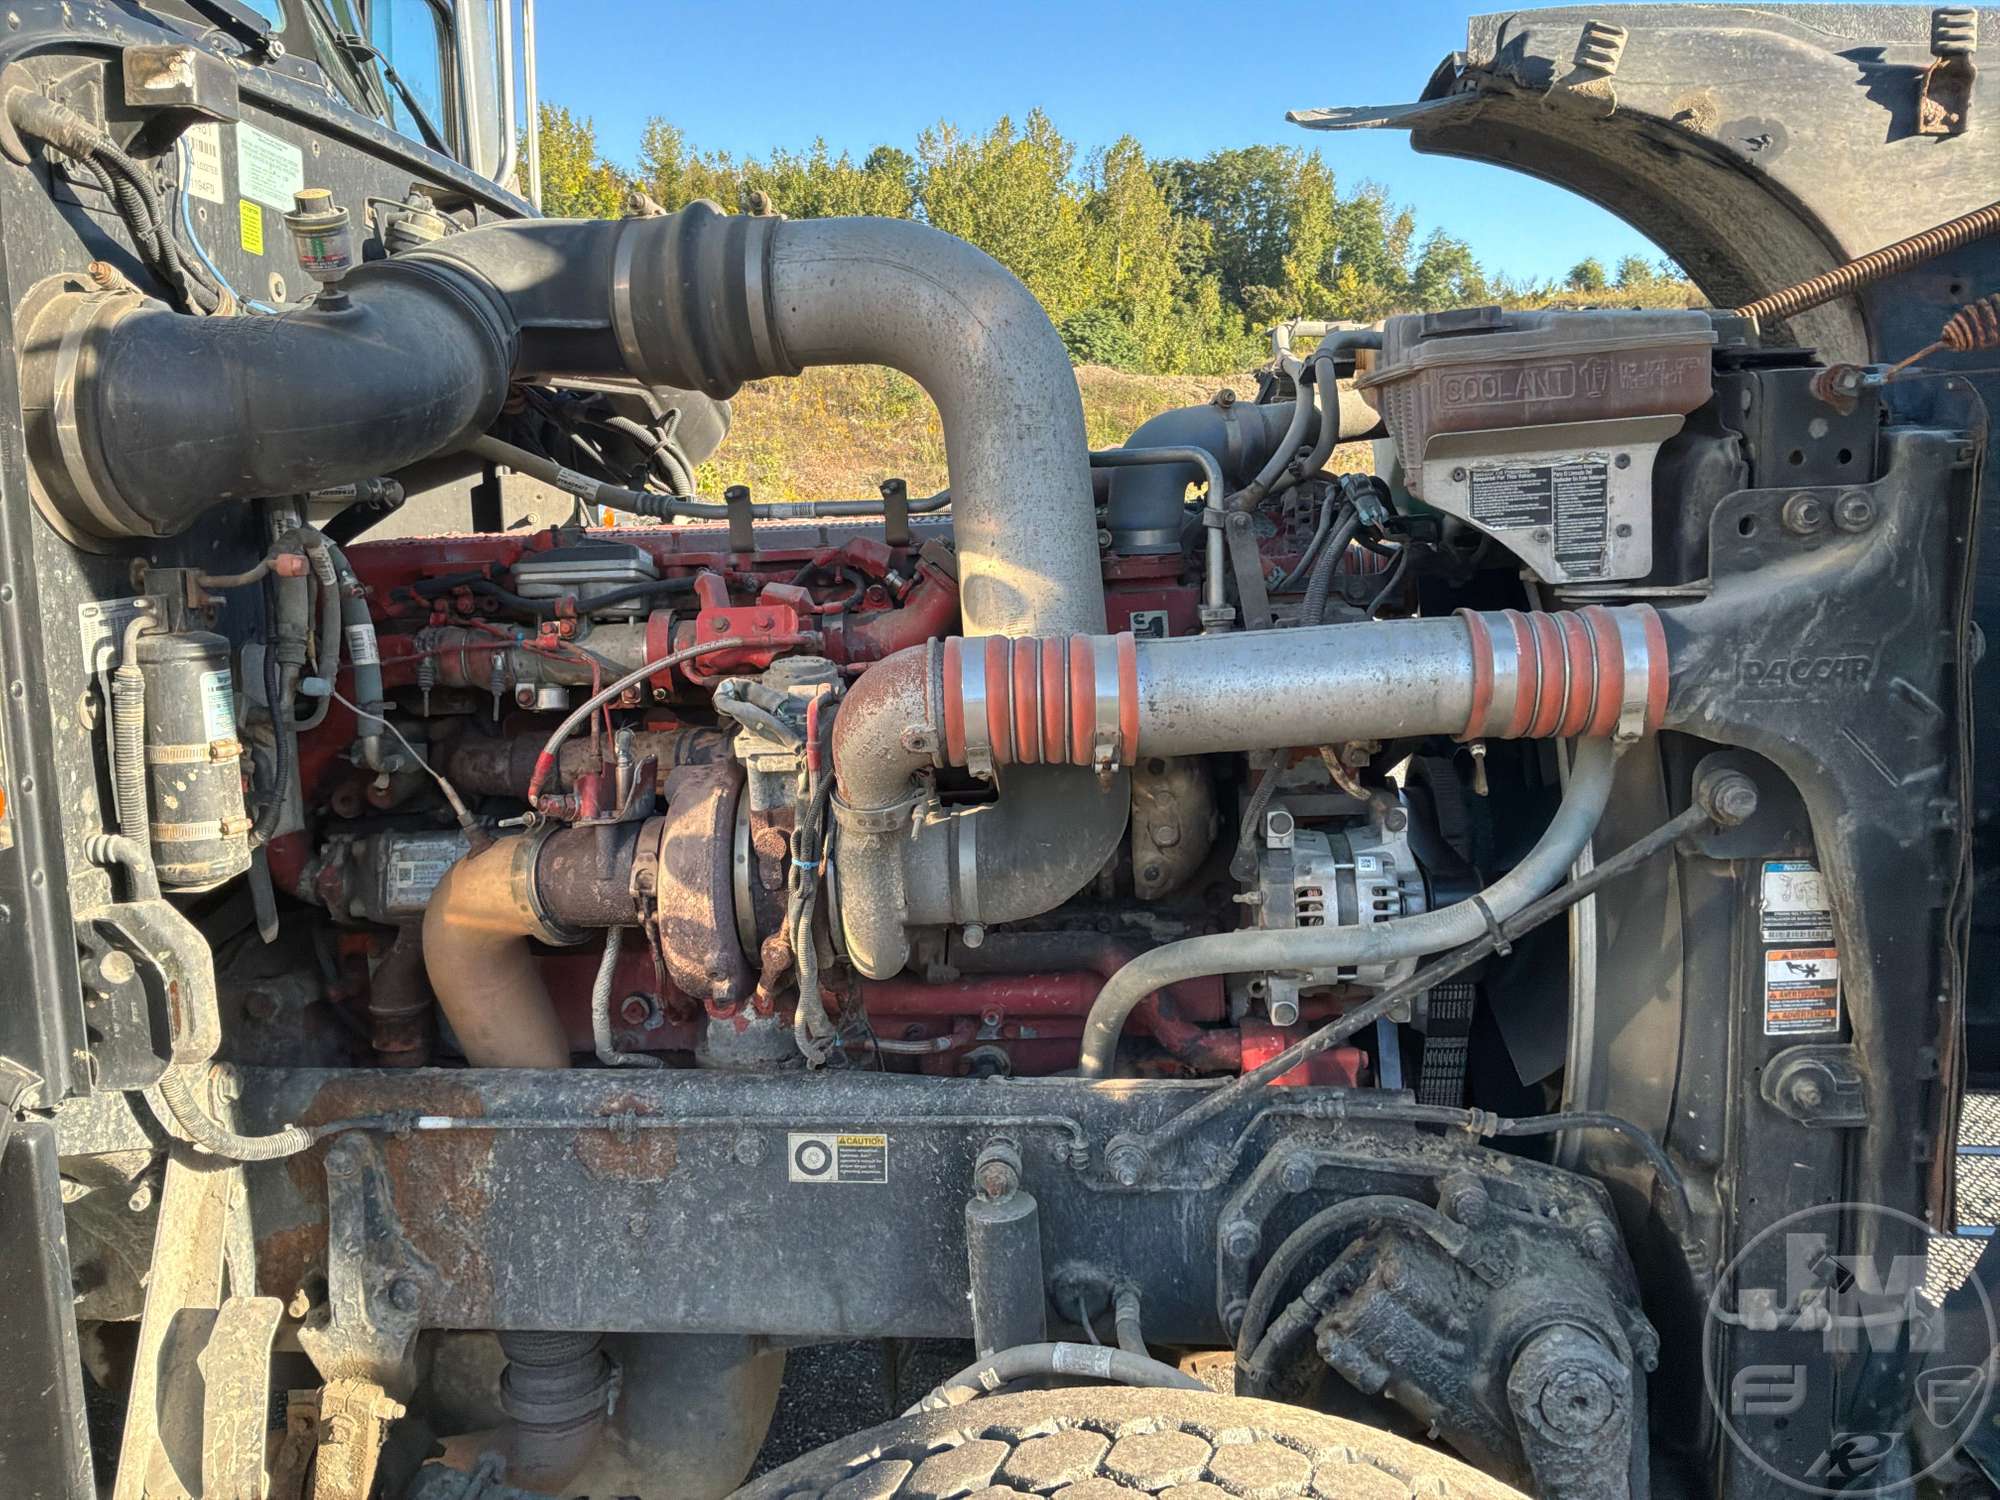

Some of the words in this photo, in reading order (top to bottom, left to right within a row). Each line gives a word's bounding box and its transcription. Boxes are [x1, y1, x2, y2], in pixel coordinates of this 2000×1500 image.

[1445, 368, 1571, 403] COOLANT
[1739, 654, 1873, 691] PACCAR
[846, 1137, 884, 1145] CAUTION
